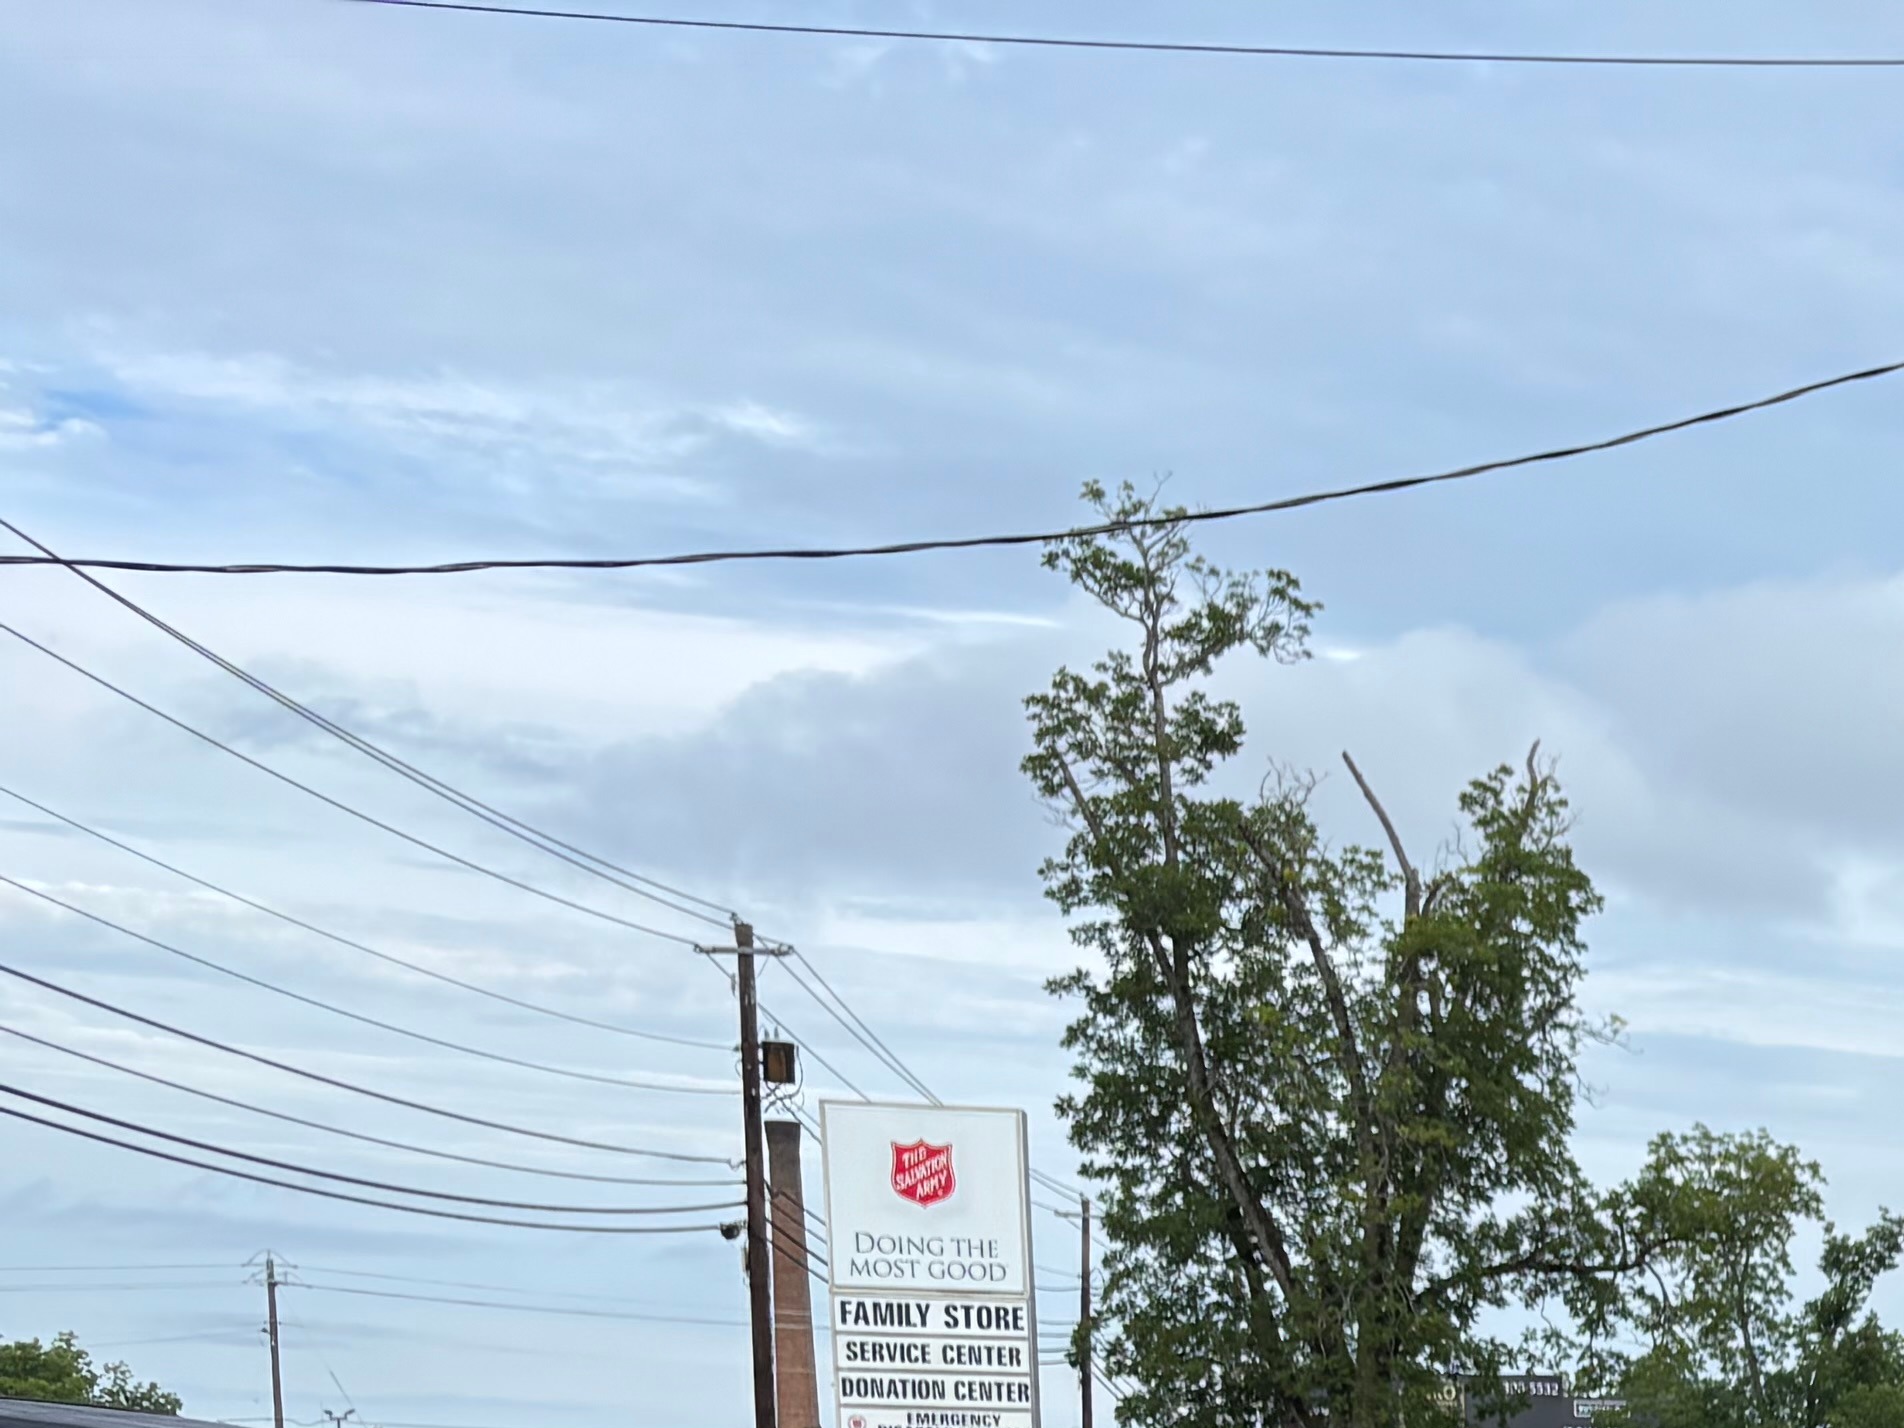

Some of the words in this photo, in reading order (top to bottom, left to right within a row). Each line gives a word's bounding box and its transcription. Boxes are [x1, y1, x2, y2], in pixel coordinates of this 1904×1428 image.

[895, 1148, 948, 1191] SALVATION
[915, 1169, 947, 1201] ARMY
[855, 1231, 944, 1257] DOING
[950, 1237, 999, 1259] THE
[850, 1257, 921, 1279] MOST
[928, 1260, 1007, 1282] GOOD
[839, 1300, 930, 1328] FAMILY
[943, 1303, 1025, 1332] STORE
[846, 1341, 932, 1365] SERVICE
[942, 1344, 1022, 1368] CENTER
[841, 1377, 946, 1401] DONATION
[954, 1380, 1030, 1403] CENTER
[907, 1412, 1001, 1428] EMERGENCY
